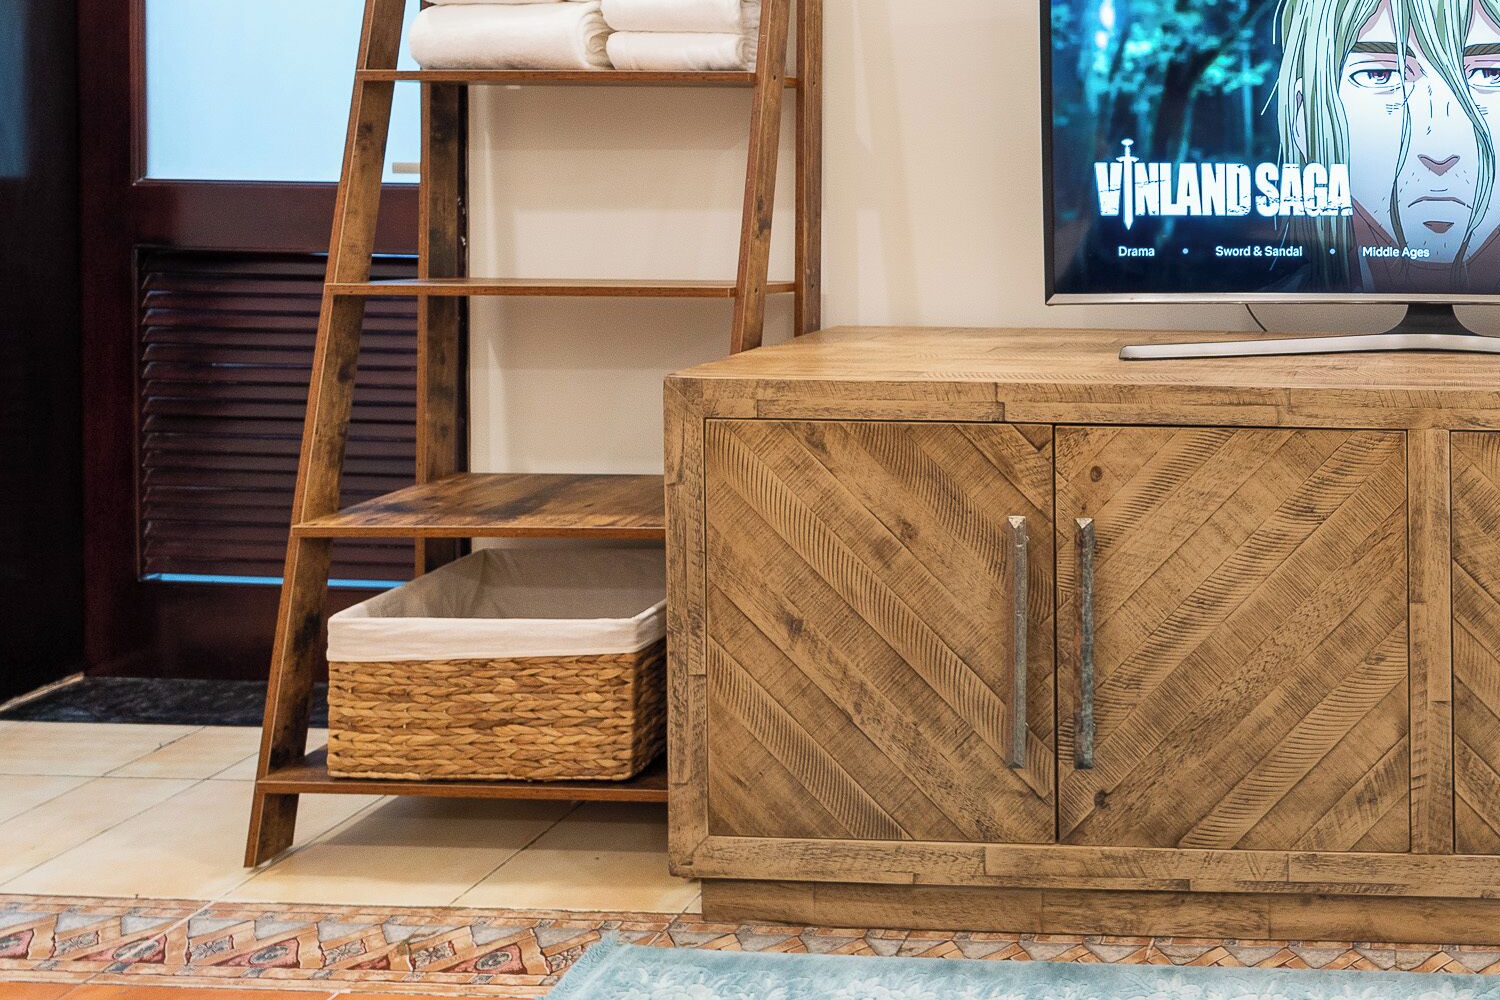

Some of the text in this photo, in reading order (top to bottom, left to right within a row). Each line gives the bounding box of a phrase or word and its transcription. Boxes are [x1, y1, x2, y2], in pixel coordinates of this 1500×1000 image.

[1093, 138, 1354, 231] VINLAND SAGA
[1118, 245, 1155, 257] Drama
[1215, 245, 1303, 257] Sword & Sandal
[1362, 246, 1430, 260] Middle Ages
